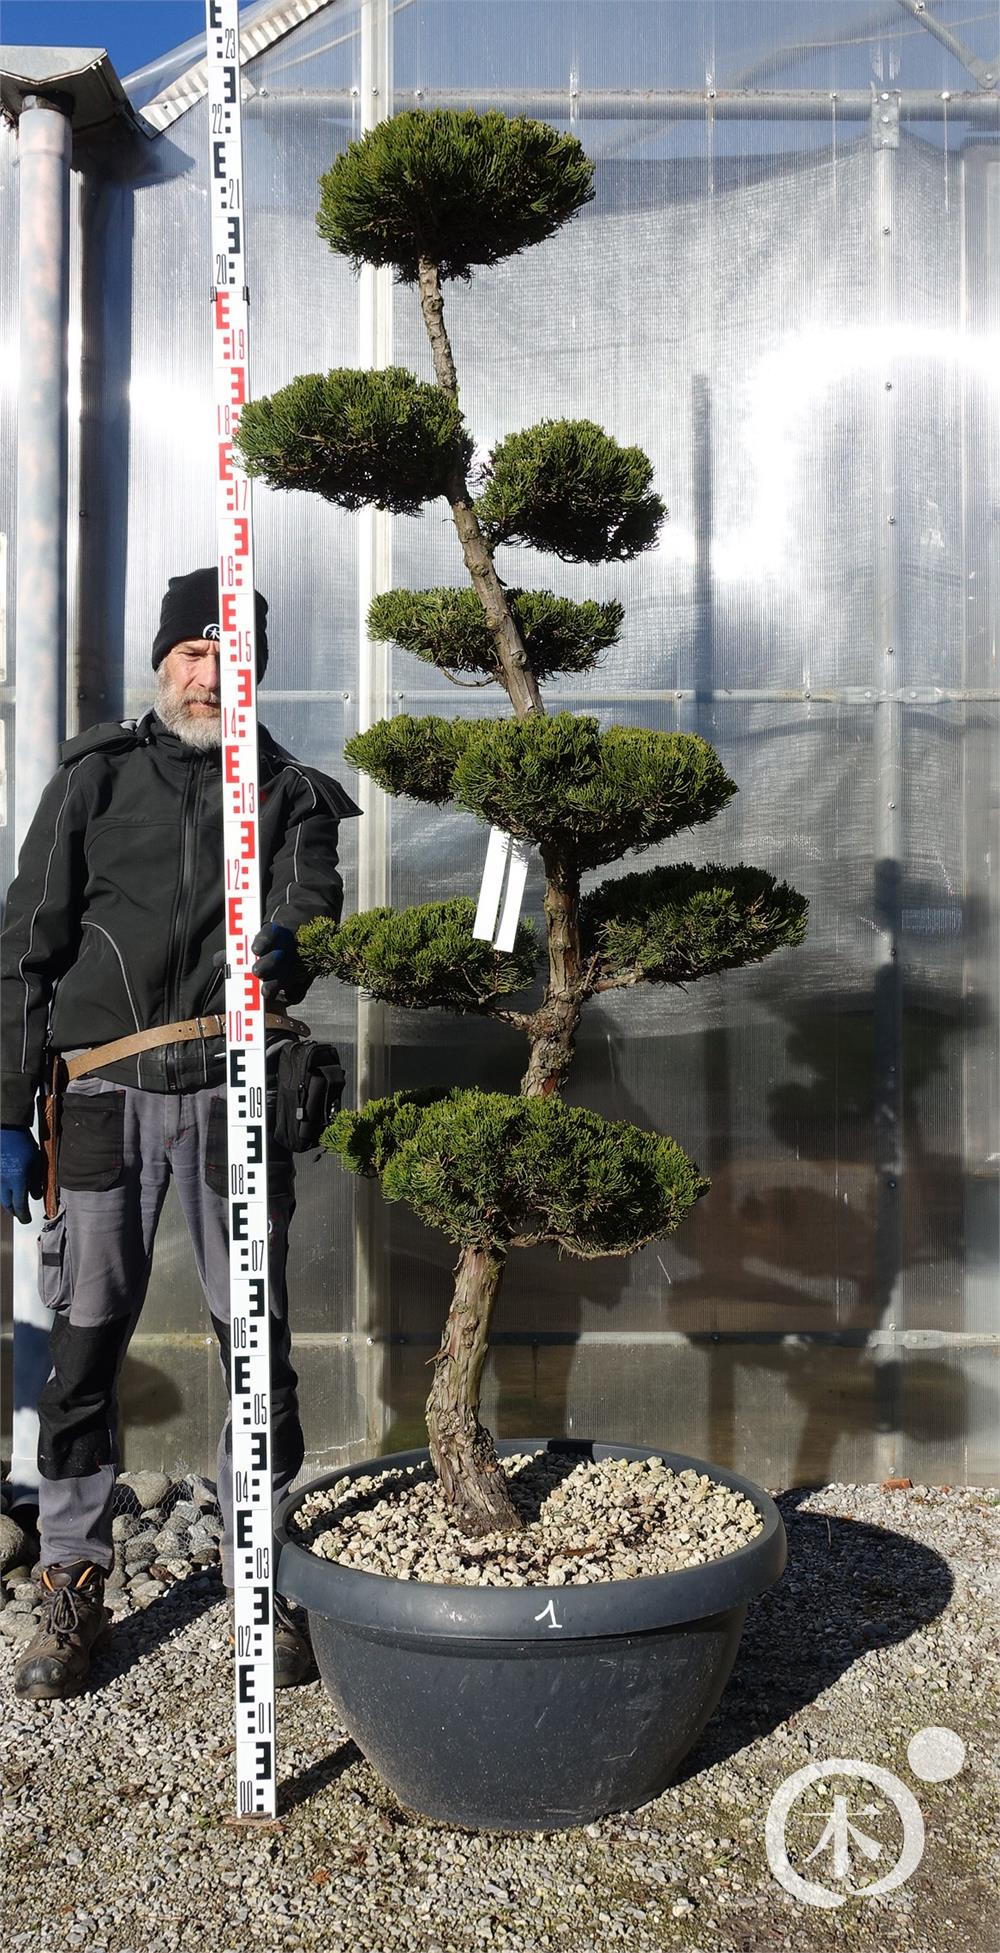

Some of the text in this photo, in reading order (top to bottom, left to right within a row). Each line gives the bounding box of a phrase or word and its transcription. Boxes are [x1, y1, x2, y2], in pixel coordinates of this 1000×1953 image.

[225, 29, 235, 59] 23
[212, 104, 222, 134] 22
[229, 179, 240, 209] 21
[216, 254, 226, 285] 20
[232, 329, 244, 360] 19
[217, 405, 229, 435] 18
[235, 480, 247, 511] 17
[221, 556, 234, 587] 16
[239, 631, 251, 662] 15
[224, 707, 236, 738] 14
[242, 783, 254, 814] 13
[228, 859, 240, 890] 12
[245, 935, 258, 964] 1
[229, 1010, 242, 1042] 10
[249, 1087, 262, 1118] 09
[231, 1163, 243, 1195] 08
[252, 1240, 264, 1271] 07
[234, 1317, 246, 1348] 06
[254, 1394, 267, 1425] 05
[236, 1471, 248, 1502] 04
[256, 1548, 269, 1579] 03
[534, 1599, 563, 1629] 1
[238, 1625, 250, 1657] 02
[258, 1702, 271, 1734] 01
[240, 1781, 253, 1812] 00
